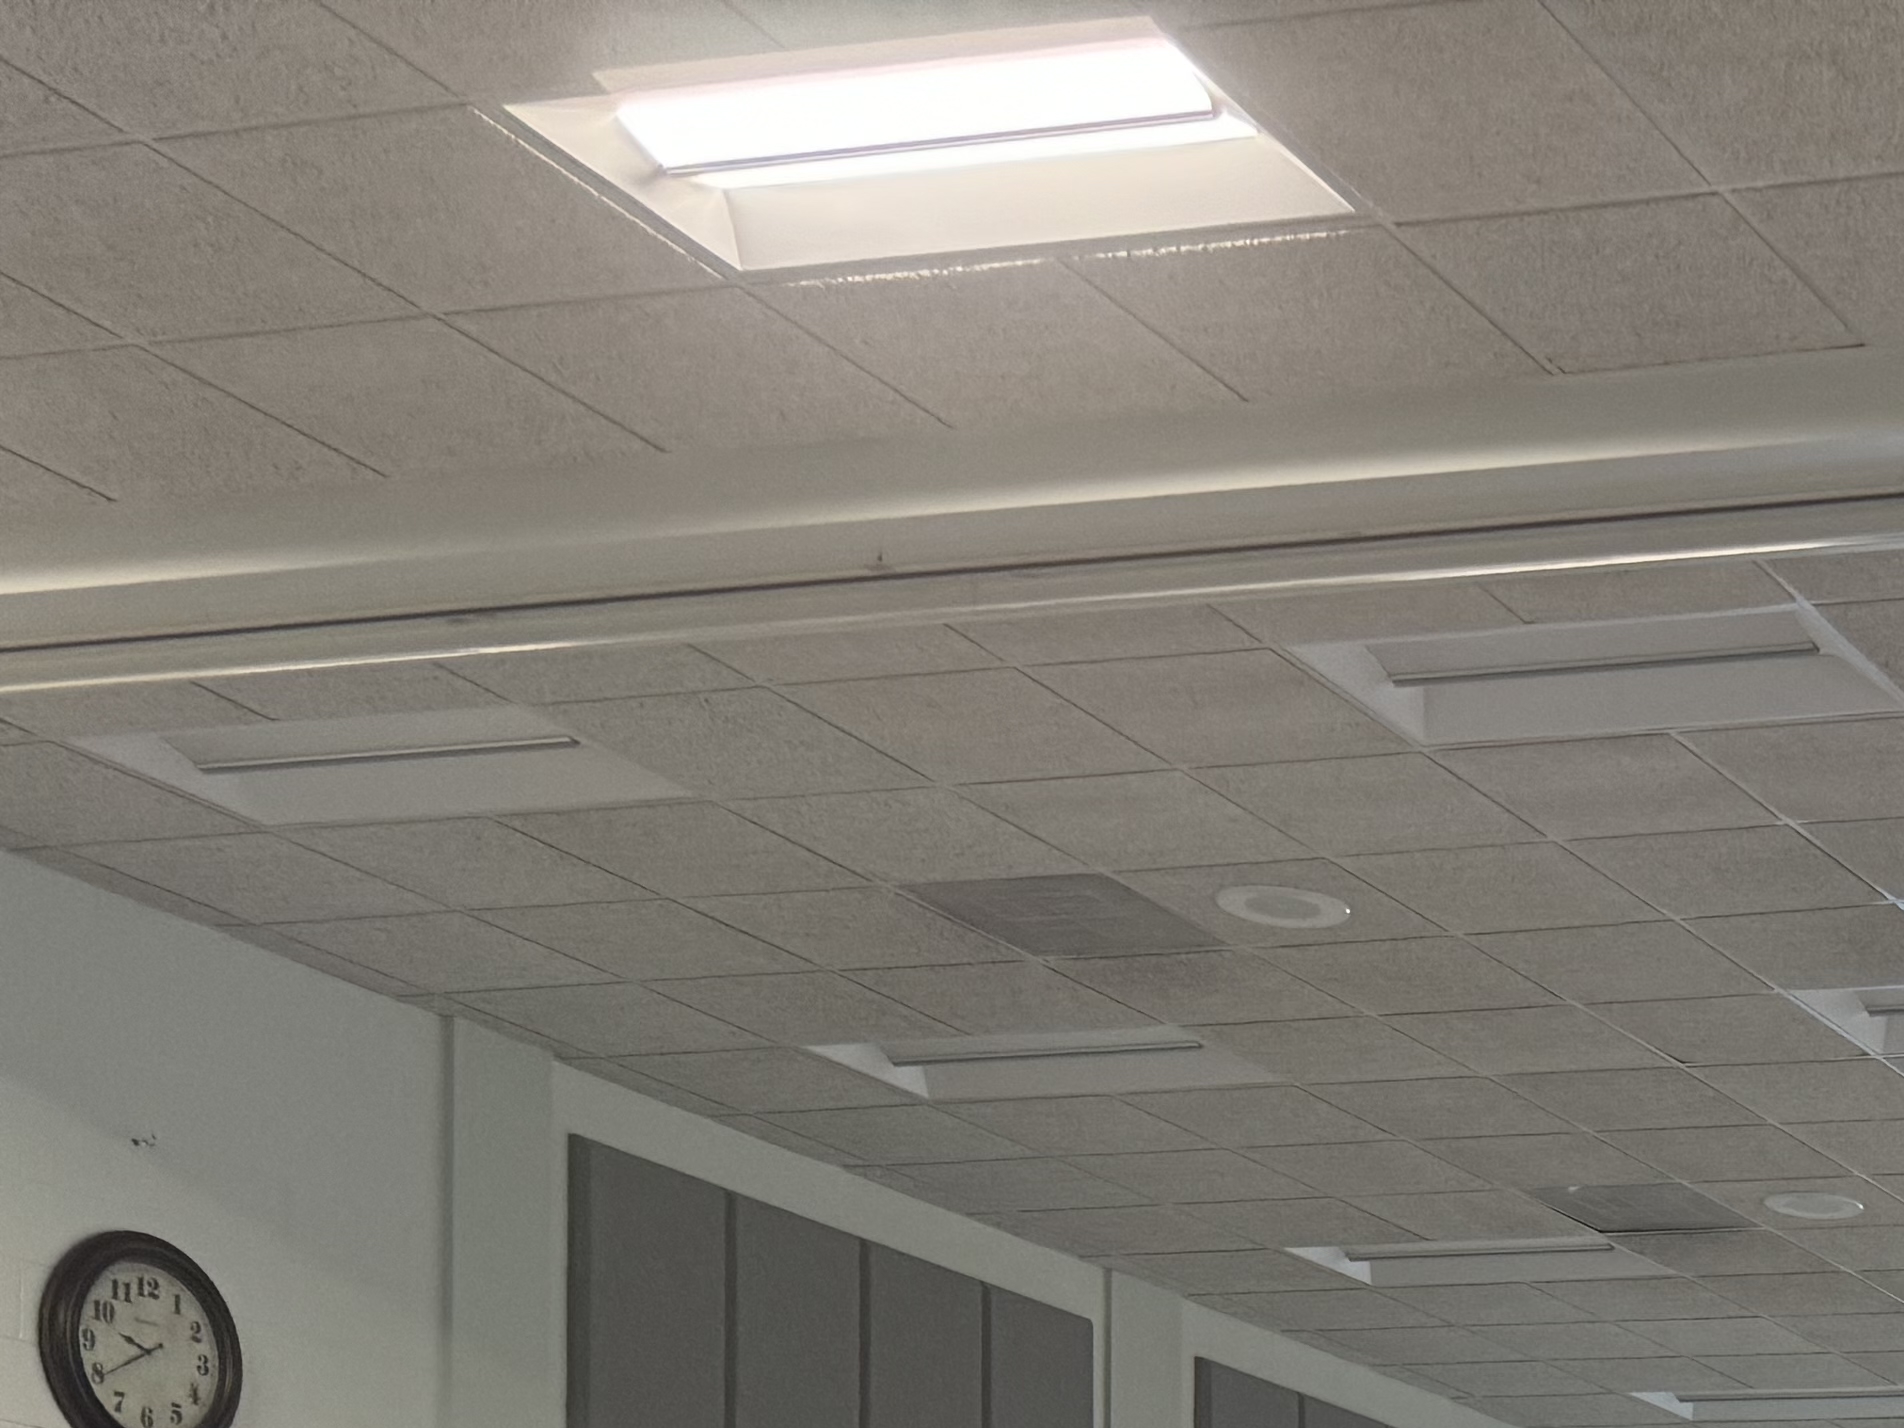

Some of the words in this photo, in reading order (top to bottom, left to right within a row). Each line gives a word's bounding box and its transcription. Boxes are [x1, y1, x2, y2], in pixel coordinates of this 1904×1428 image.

[111, 1279, 132, 1303] 11
[137, 1276, 160, 1300] 12
[93, 1300, 115, 1324] 10
[173, 1294, 182, 1315] 1
[81, 1328, 96, 1351] 9
[190, 1321, 202, 1344] 2
[91, 1362, 105, 1386] 8
[197, 1354, 209, 1376] 3
[113, 1391, 125, 1414] 7
[170, 1402, 183, 1425] 5
[140, 1407, 154, 1428] 6
